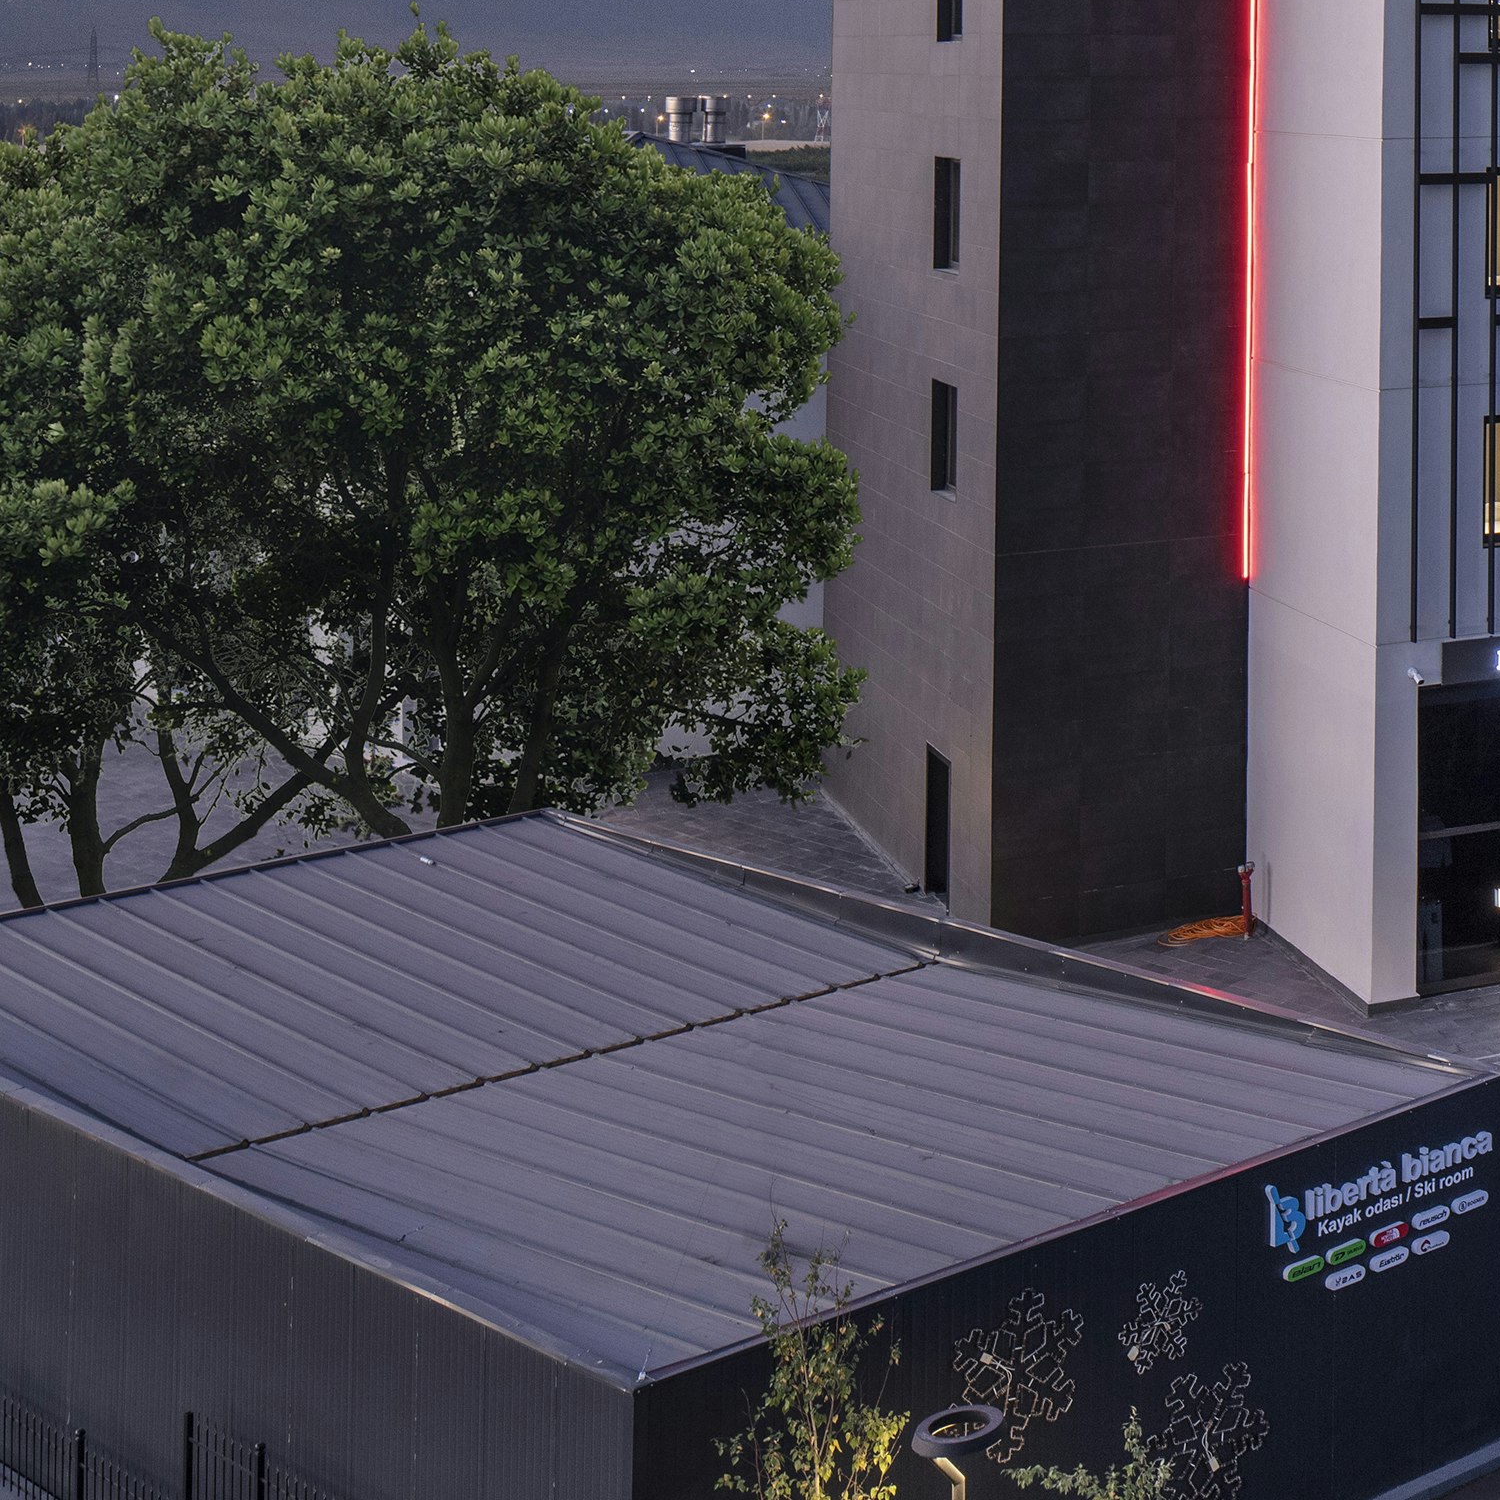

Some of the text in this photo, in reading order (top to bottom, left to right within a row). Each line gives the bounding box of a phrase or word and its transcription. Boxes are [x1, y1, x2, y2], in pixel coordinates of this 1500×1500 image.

[1305, 1160, 1397, 1221] libertà
[1401, 1130, 1493, 1183] bianca
[1317, 1208, 1362, 1237] Kayak
[1365, 1193, 1403, 1218] odası
[1414, 1178, 1436, 1199] Ski
[1439, 1166, 1474, 1190] room
[1419, 1209, 1447, 1227] reusch
[1292, 1261, 1321, 1279] elan
